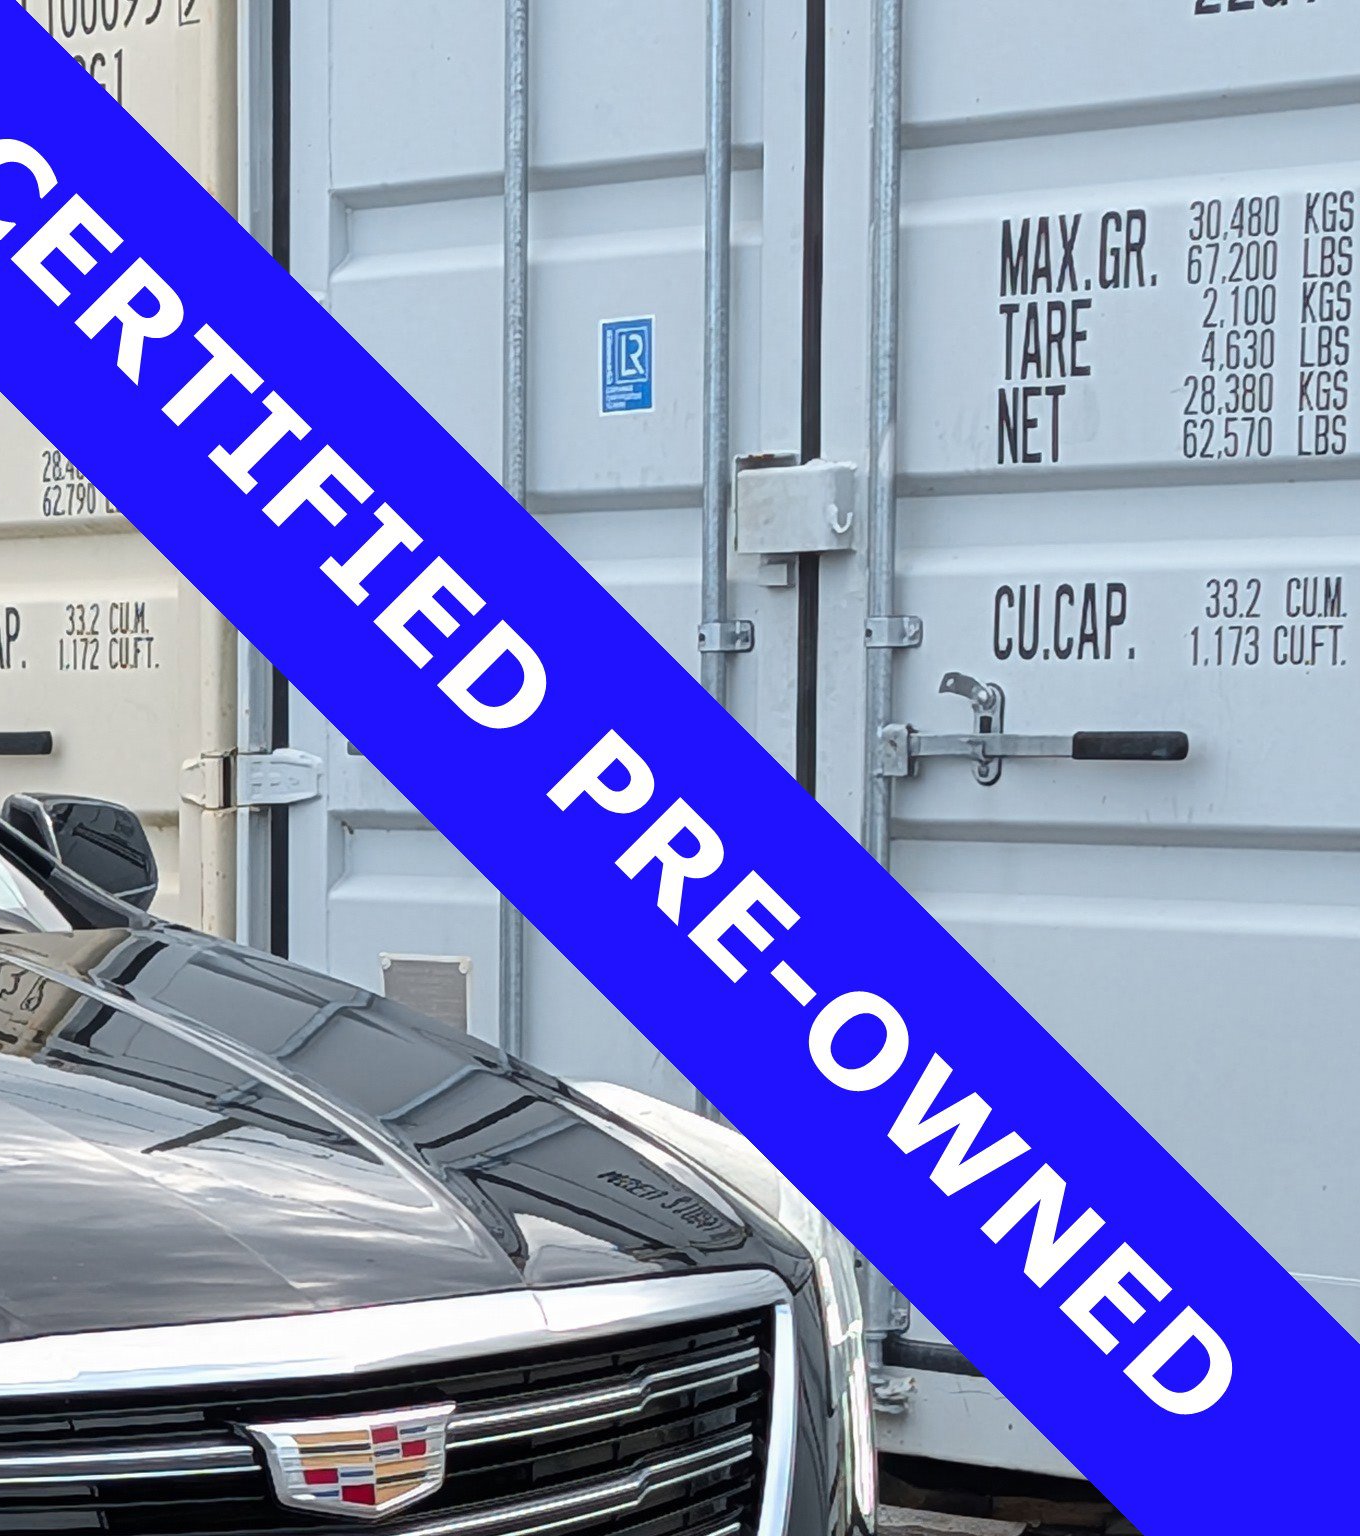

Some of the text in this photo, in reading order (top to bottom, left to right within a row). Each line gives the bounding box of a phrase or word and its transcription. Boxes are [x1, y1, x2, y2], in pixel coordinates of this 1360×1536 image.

[1189, 190, 1355, 241] 30,480 KGS
[1187, 235, 1353, 285] 67,200 LBS
[1202, 280, 1352, 329] 2,100 KGS
[999, 298, 1092, 381] TARE
[1201, 325, 1350, 372] 4,630 LBS
[1183, 369, 1349, 416] 28,380 KGS
[997, 385, 1066, 465] NET
[1183, 414, 1347, 460] 62,570 LBS
[65, 603, 100, 636] 33.2
[1205, 578, 1262, 618] 33.2
